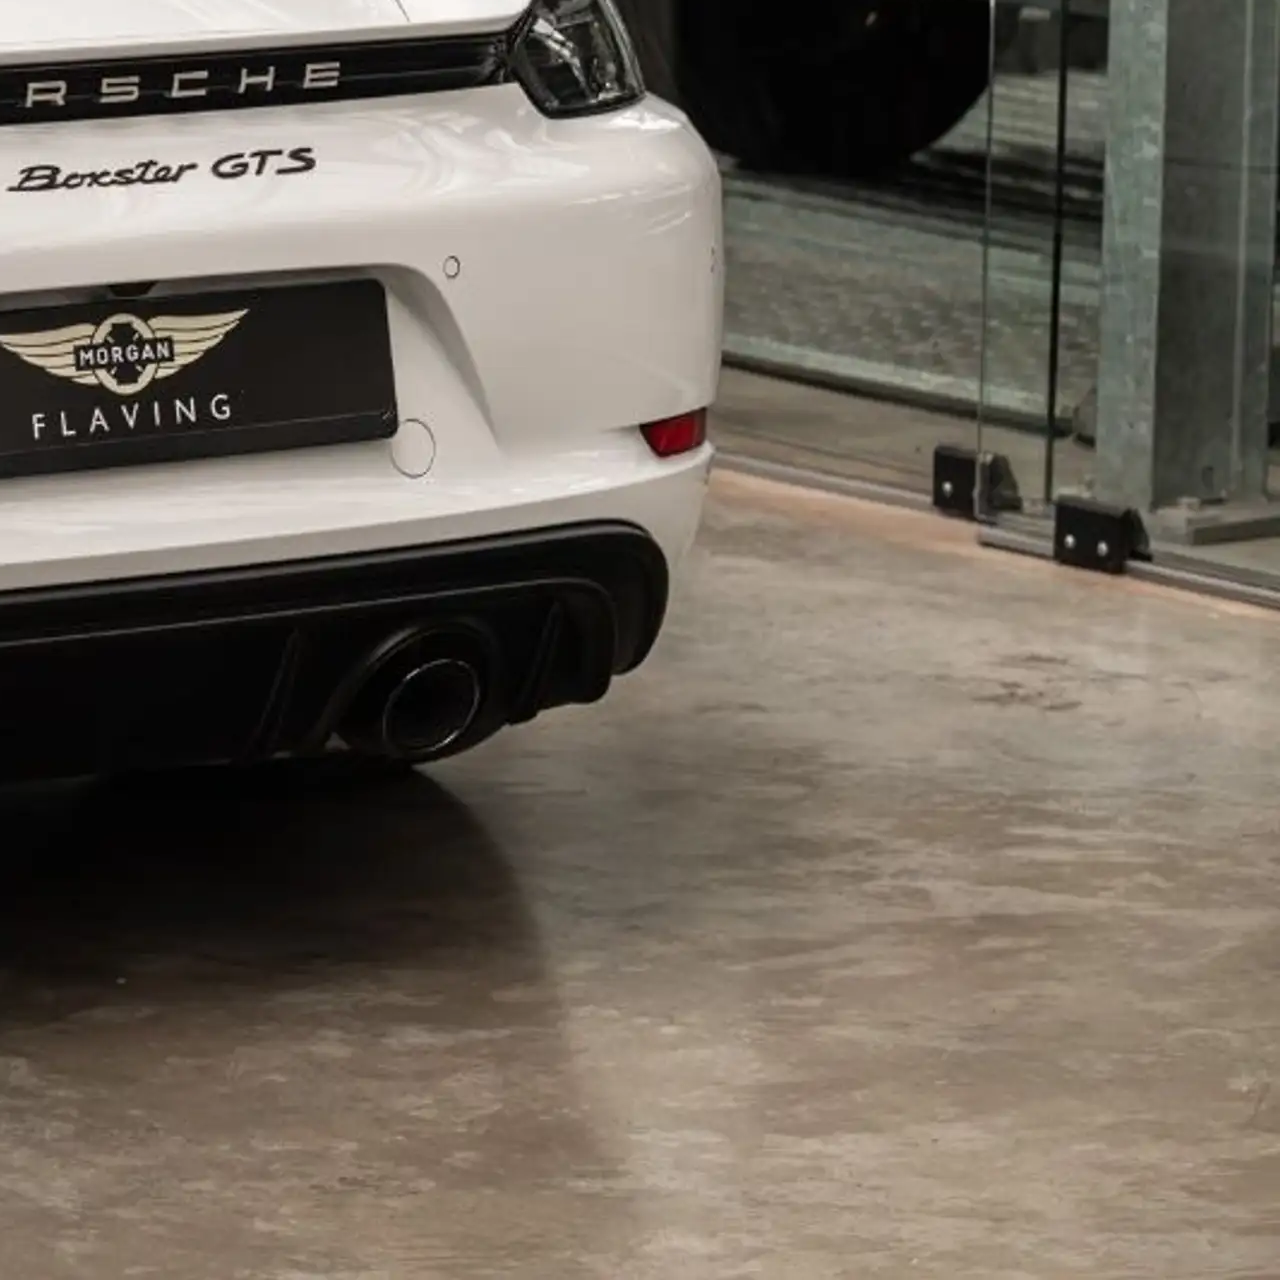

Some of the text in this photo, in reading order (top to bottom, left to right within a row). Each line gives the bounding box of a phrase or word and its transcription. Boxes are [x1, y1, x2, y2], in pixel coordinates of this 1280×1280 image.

[6, 158, 199, 192] Boxster
[210, 147, 317, 180] GTS
[78, 341, 171, 367] MORGAN
[31, 393, 232, 441] FLAVING
